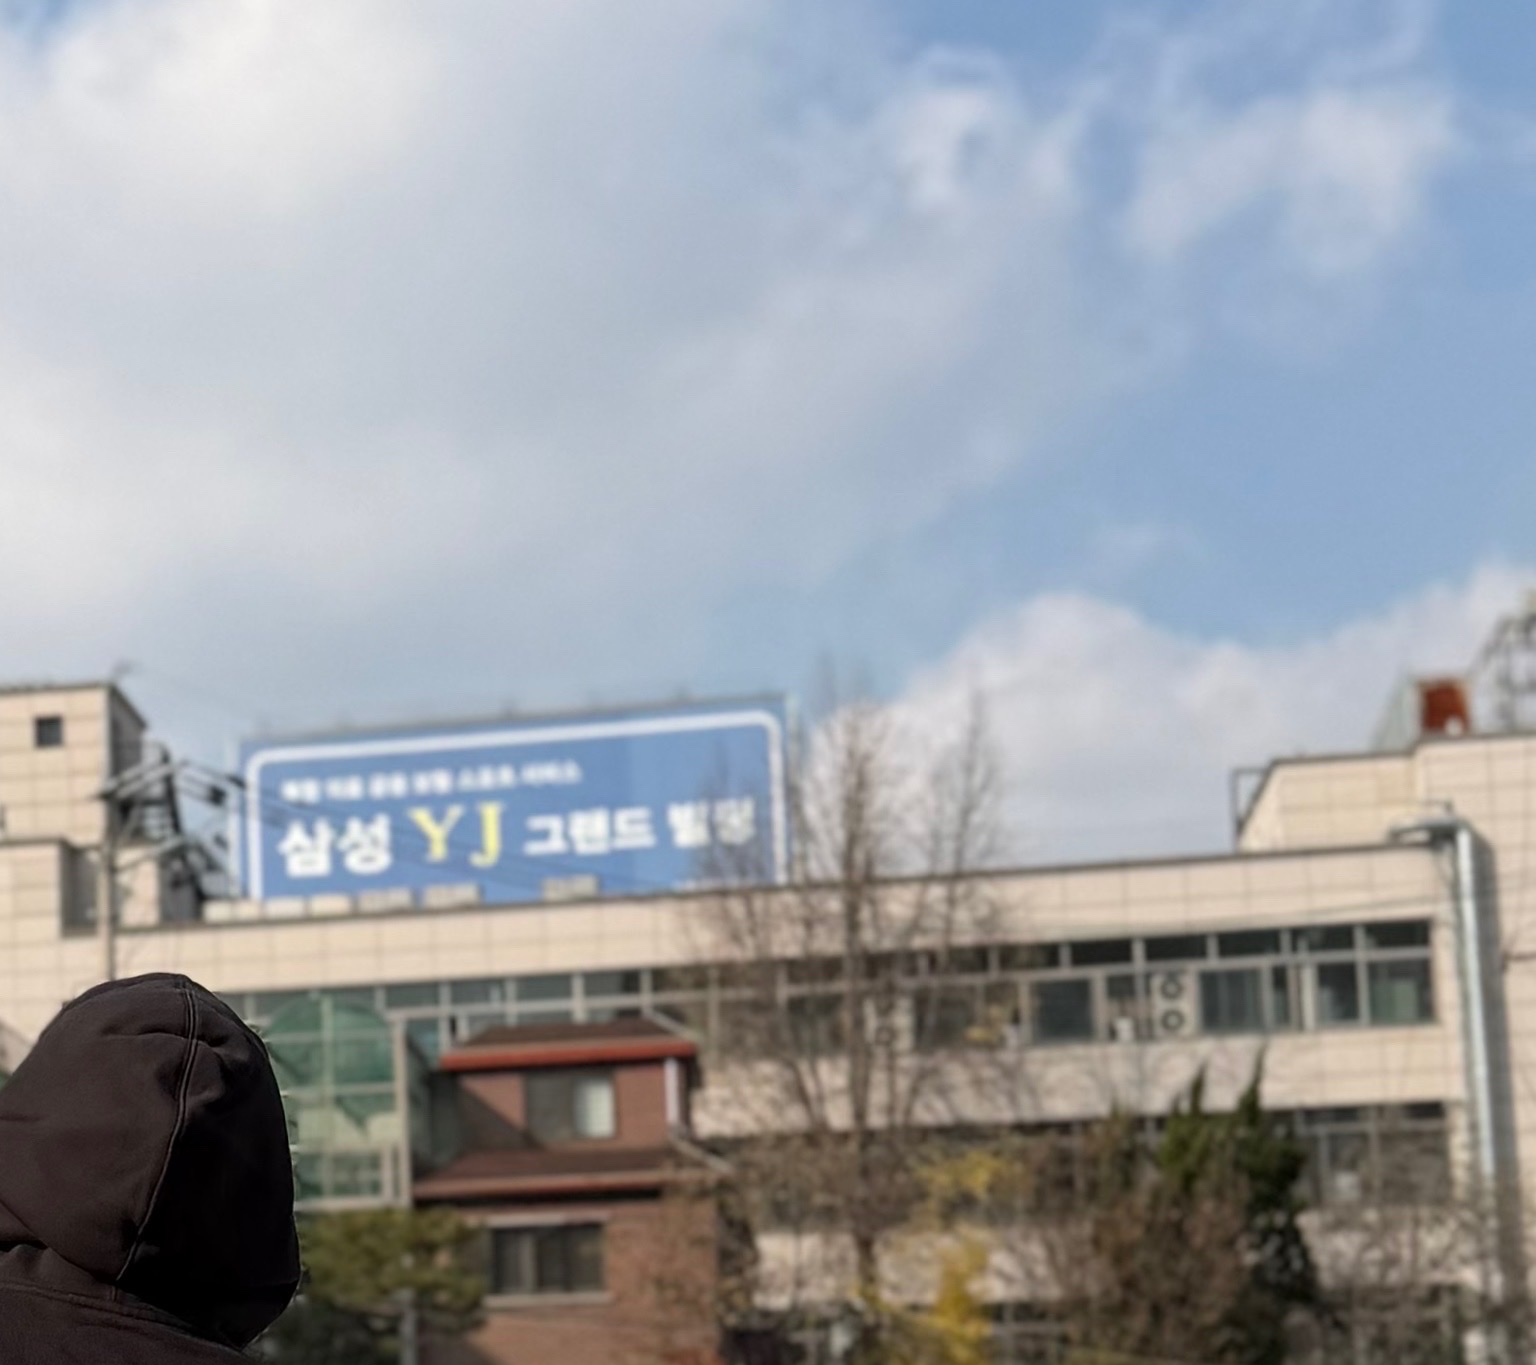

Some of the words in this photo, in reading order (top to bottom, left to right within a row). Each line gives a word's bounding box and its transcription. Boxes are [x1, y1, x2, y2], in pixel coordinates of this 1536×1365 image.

[279, 814, 391, 877] 삼성
[409, 801, 504, 867] YJ
[668, 798, 755, 848] 빌딩
